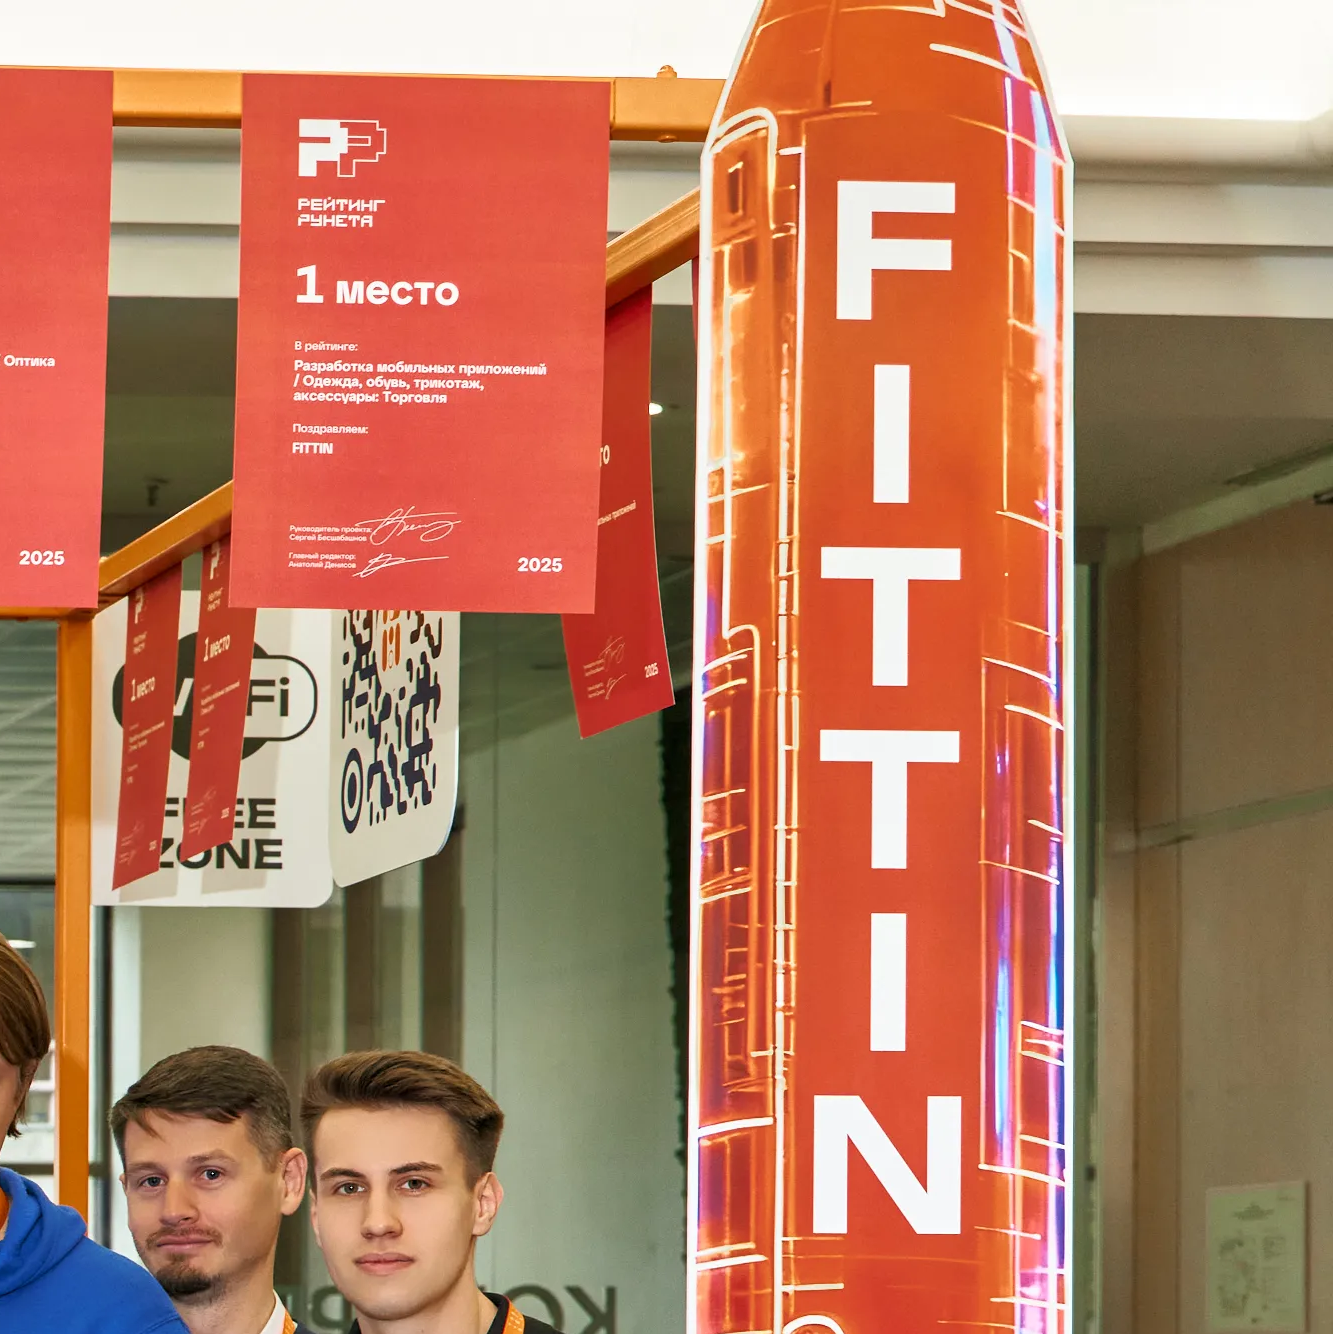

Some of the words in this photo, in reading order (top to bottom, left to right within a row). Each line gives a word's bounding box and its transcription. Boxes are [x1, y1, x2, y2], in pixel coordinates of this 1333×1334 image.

[296, 264, 323, 303] 1
[335, 280, 459, 306] место
[3, 354, 55, 366] Оптика
[294, 359, 373, 374] Разработка
[376, 360, 455, 373] мобильных
[458, 363, 546, 376] приложений
[302, 374, 362, 388] Одежда,
[365, 375, 410, 390] обувь,
[413, 378, 484, 391] трикотаж,
[292, 391, 379, 404] аксессуары:
[382, 390, 447, 405] Торговля
[292, 441, 333, 453] FITTIN
[19, 550, 64, 565] 2025
[517, 556, 562, 572] 2025
[812, 181, 962, 1236] FITTIN
